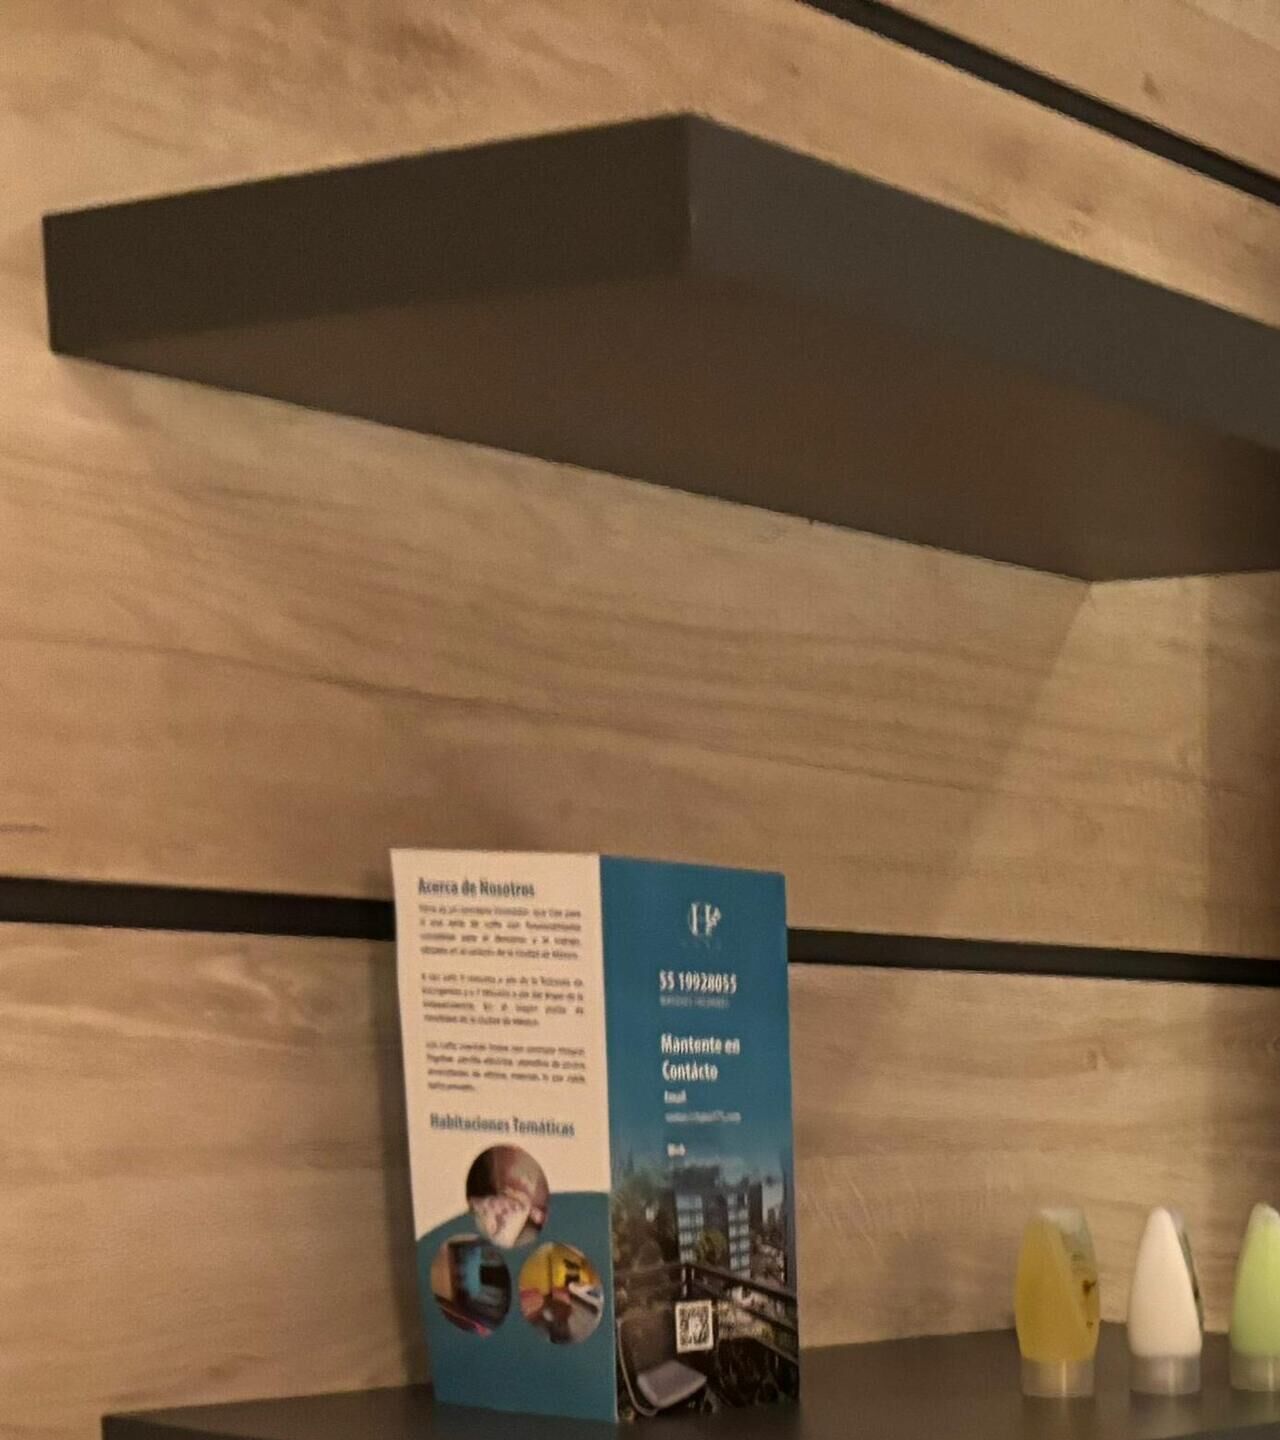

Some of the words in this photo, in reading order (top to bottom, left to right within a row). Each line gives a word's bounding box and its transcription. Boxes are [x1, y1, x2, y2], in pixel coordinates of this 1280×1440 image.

[418, 877, 459, 896] Acerca
[461, 879, 477, 897] de
[479, 880, 535, 898] Nosotros
[661, 1033, 722, 1054] Mantente
[724, 1037, 740, 1054] en
[430, 1112, 510, 1133] Habitaciones
